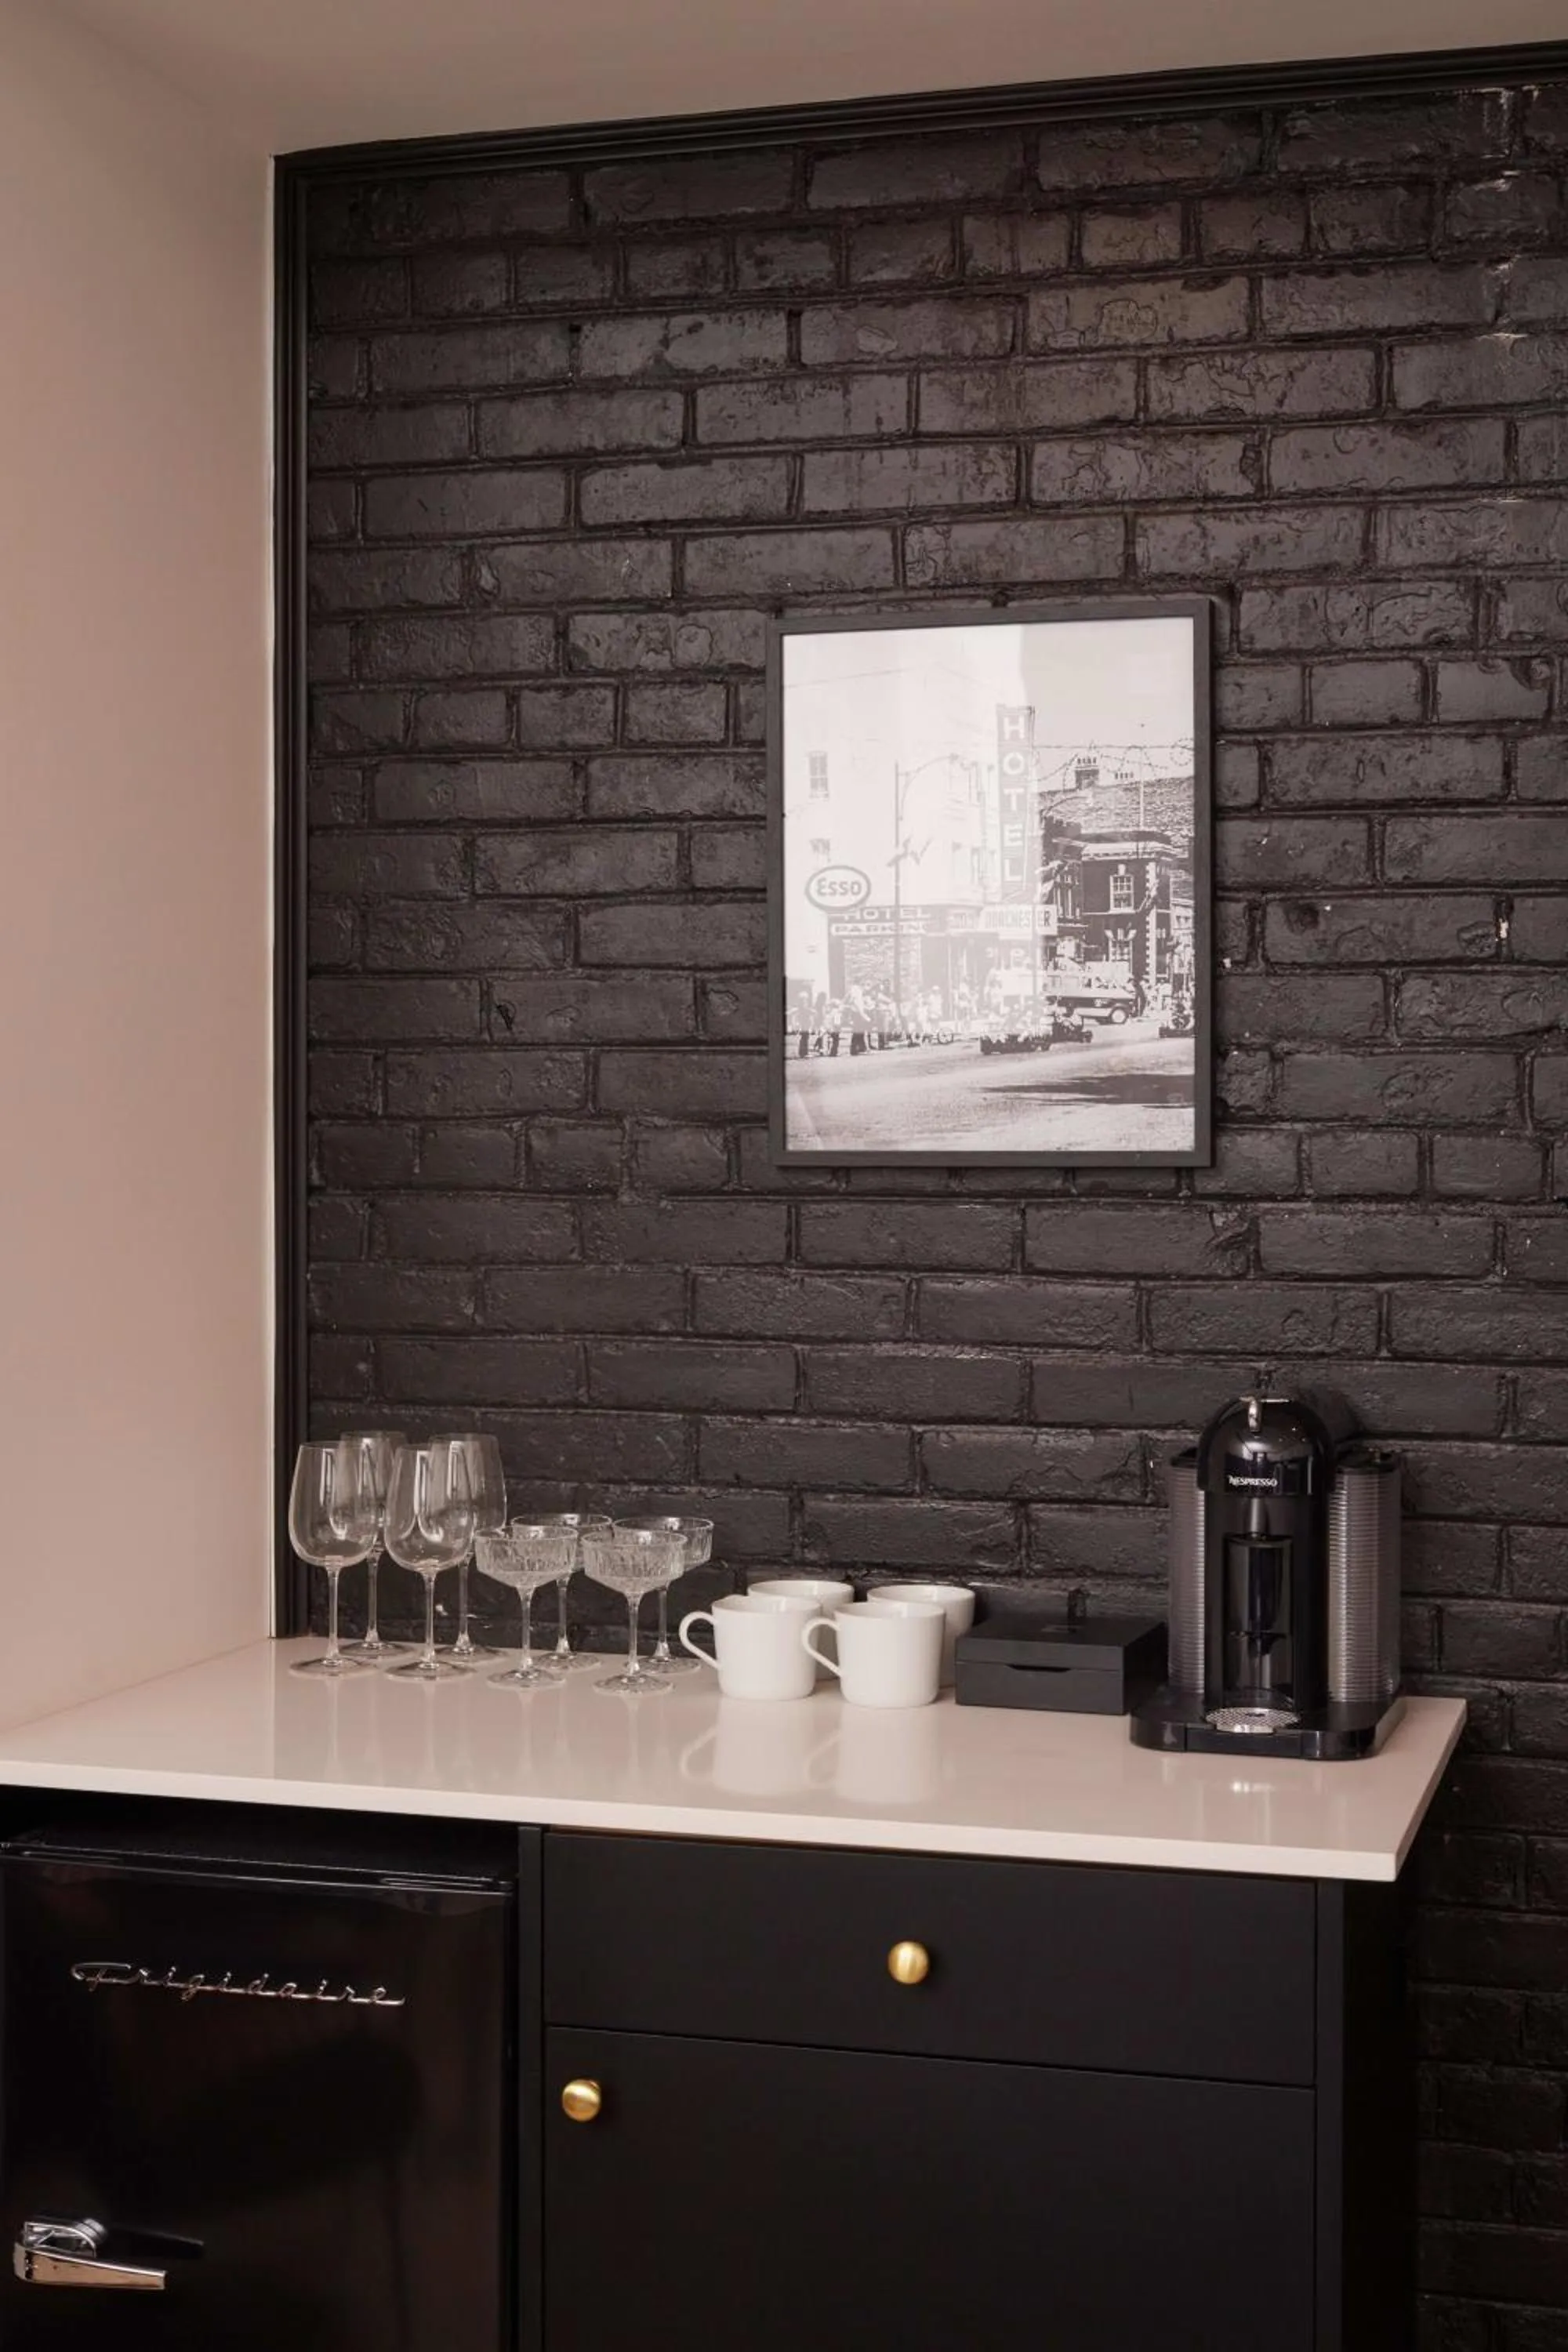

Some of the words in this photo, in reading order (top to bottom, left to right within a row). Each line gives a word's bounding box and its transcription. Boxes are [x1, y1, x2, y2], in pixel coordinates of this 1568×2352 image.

[1003, 714, 1025, 882] HOTEL
[844, 906, 931, 921] HOTEL
[1228, 1475, 1278, 1487] NESPRESSO
[71, 1962, 406, 2005] Frigidaire
